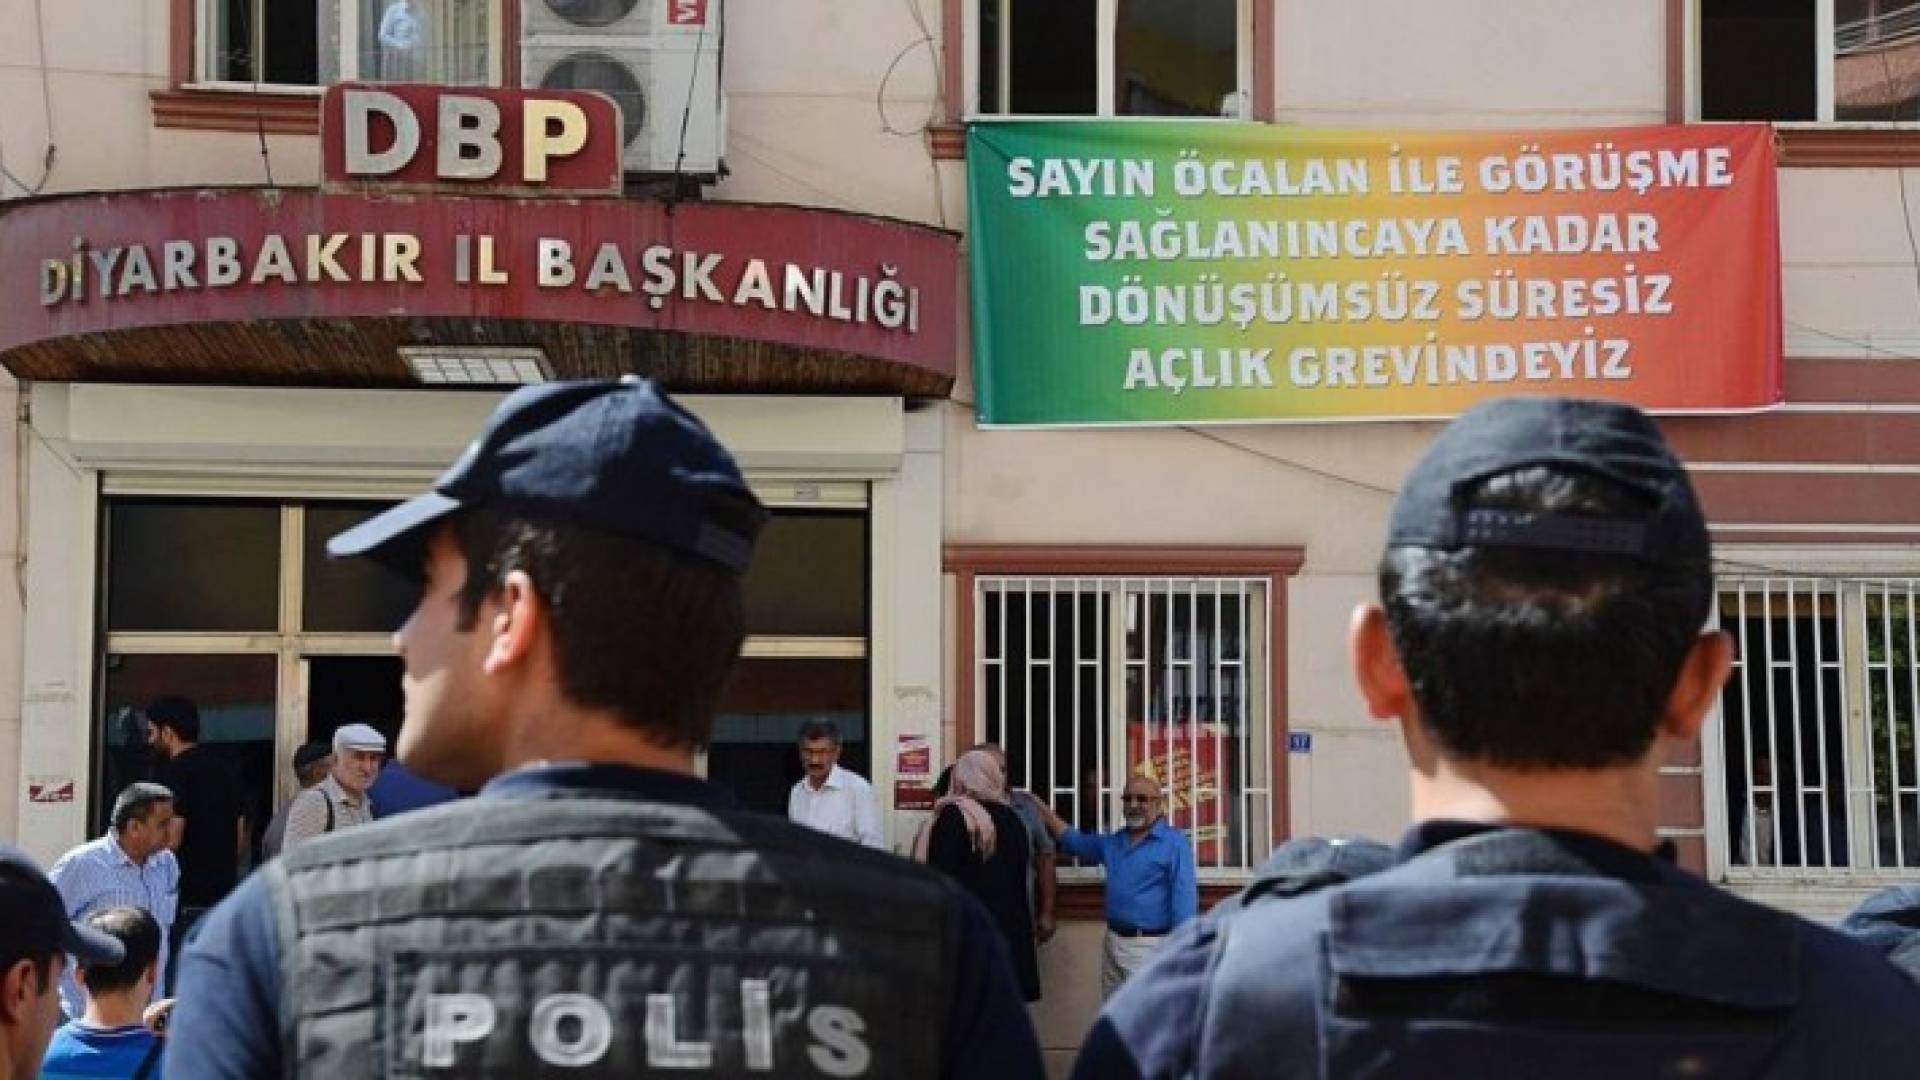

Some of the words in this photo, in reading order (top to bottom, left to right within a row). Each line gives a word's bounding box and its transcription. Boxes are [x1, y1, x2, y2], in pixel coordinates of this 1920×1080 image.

[344, 90, 589, 182] DBP
[1007, 156, 1155, 198] SAYIN
[1173, 149, 1369, 196] ÖCALAN
[1388, 143, 1465, 194] İLE
[1478, 142, 1735, 196] GÖRÜŞME
[1084, 208, 1471, 261] SAĞLANINCAYA
[1484, 212, 1661, 256] KADAR
[39, 232, 423, 307] DİYARBAKIR
[536, 236, 919, 333] BAŞKANLIĞI
[1079, 271, 1442, 331] DÖNÜŞÜMSÜZ
[1457, 264, 1674, 320] SÜRESİZ
[1123, 347, 1273, 396] AÇLIK
[1289, 326, 1632, 390] GREVİNDEYİZ
